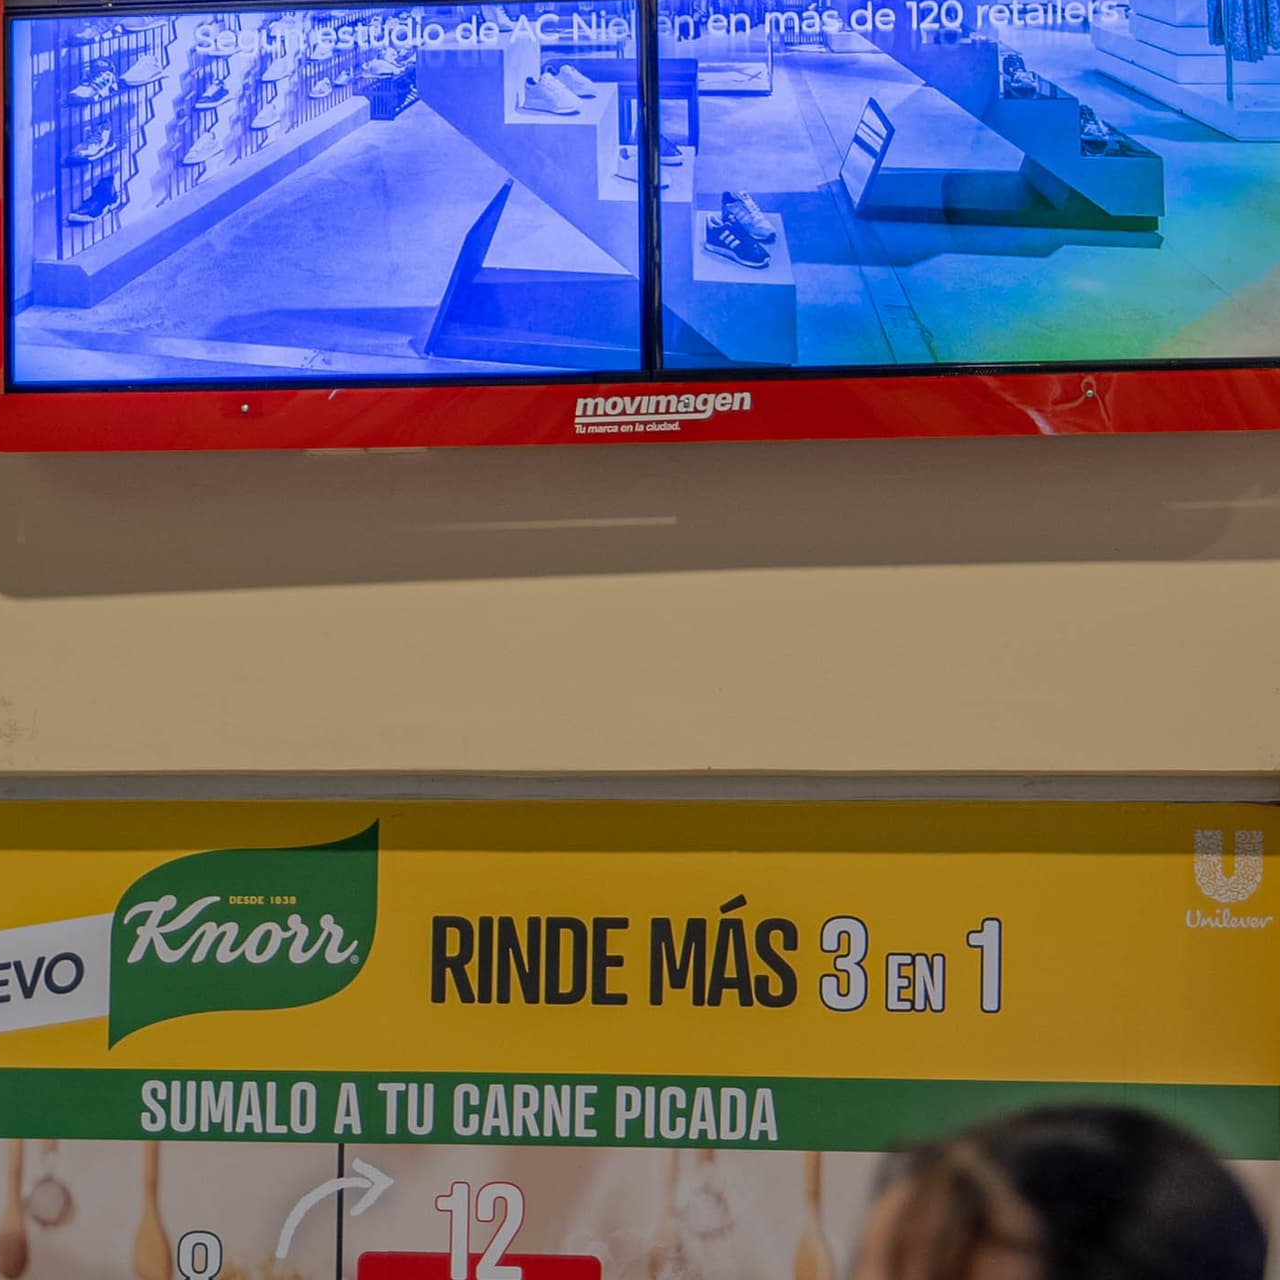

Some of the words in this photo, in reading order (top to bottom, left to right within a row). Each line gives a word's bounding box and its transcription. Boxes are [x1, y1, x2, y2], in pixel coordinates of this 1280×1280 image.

[317, 20, 446, 52] estudio
[456, 15, 500, 42] de
[509, 12, 560, 44] AC
[570, 10, 696, 41] Nielen
[707, 12, 751, 33] en
[764, 2, 840, 34] más
[850, 1, 896, 31] de
[906, 0, 964, 31] 120
[575, 391, 752, 421] movimagen
[575, 424, 586, 434] Tu
[587, 425, 618, 433] marca
[620, 425, 633, 433] en
[634, 423, 644, 432] la
[646, 421, 681, 432] ciudad.
[229, 895, 265, 905] DESDE
[270, 895, 297, 905] 1838
[1186, 909, 1273, 928] Unilever
[123, 894, 359, 965] Knorr
[431, 915, 630, 1006] RINDE
[649, 893, 799, 1008] MÁS
[819, 915, 869, 1012] 3
[885, 953, 946, 1013] EN
[966, 916, 1002, 1013] 1
[140, 1079, 317, 1135] SUMALO
[333, 1081, 363, 1135] A
[377, 1082, 435, 1136] TU
[452, 1083, 599, 1138] CARNE
[615, 1085, 779, 1141] PICADA
[434, 1181, 526, 1280] 12
